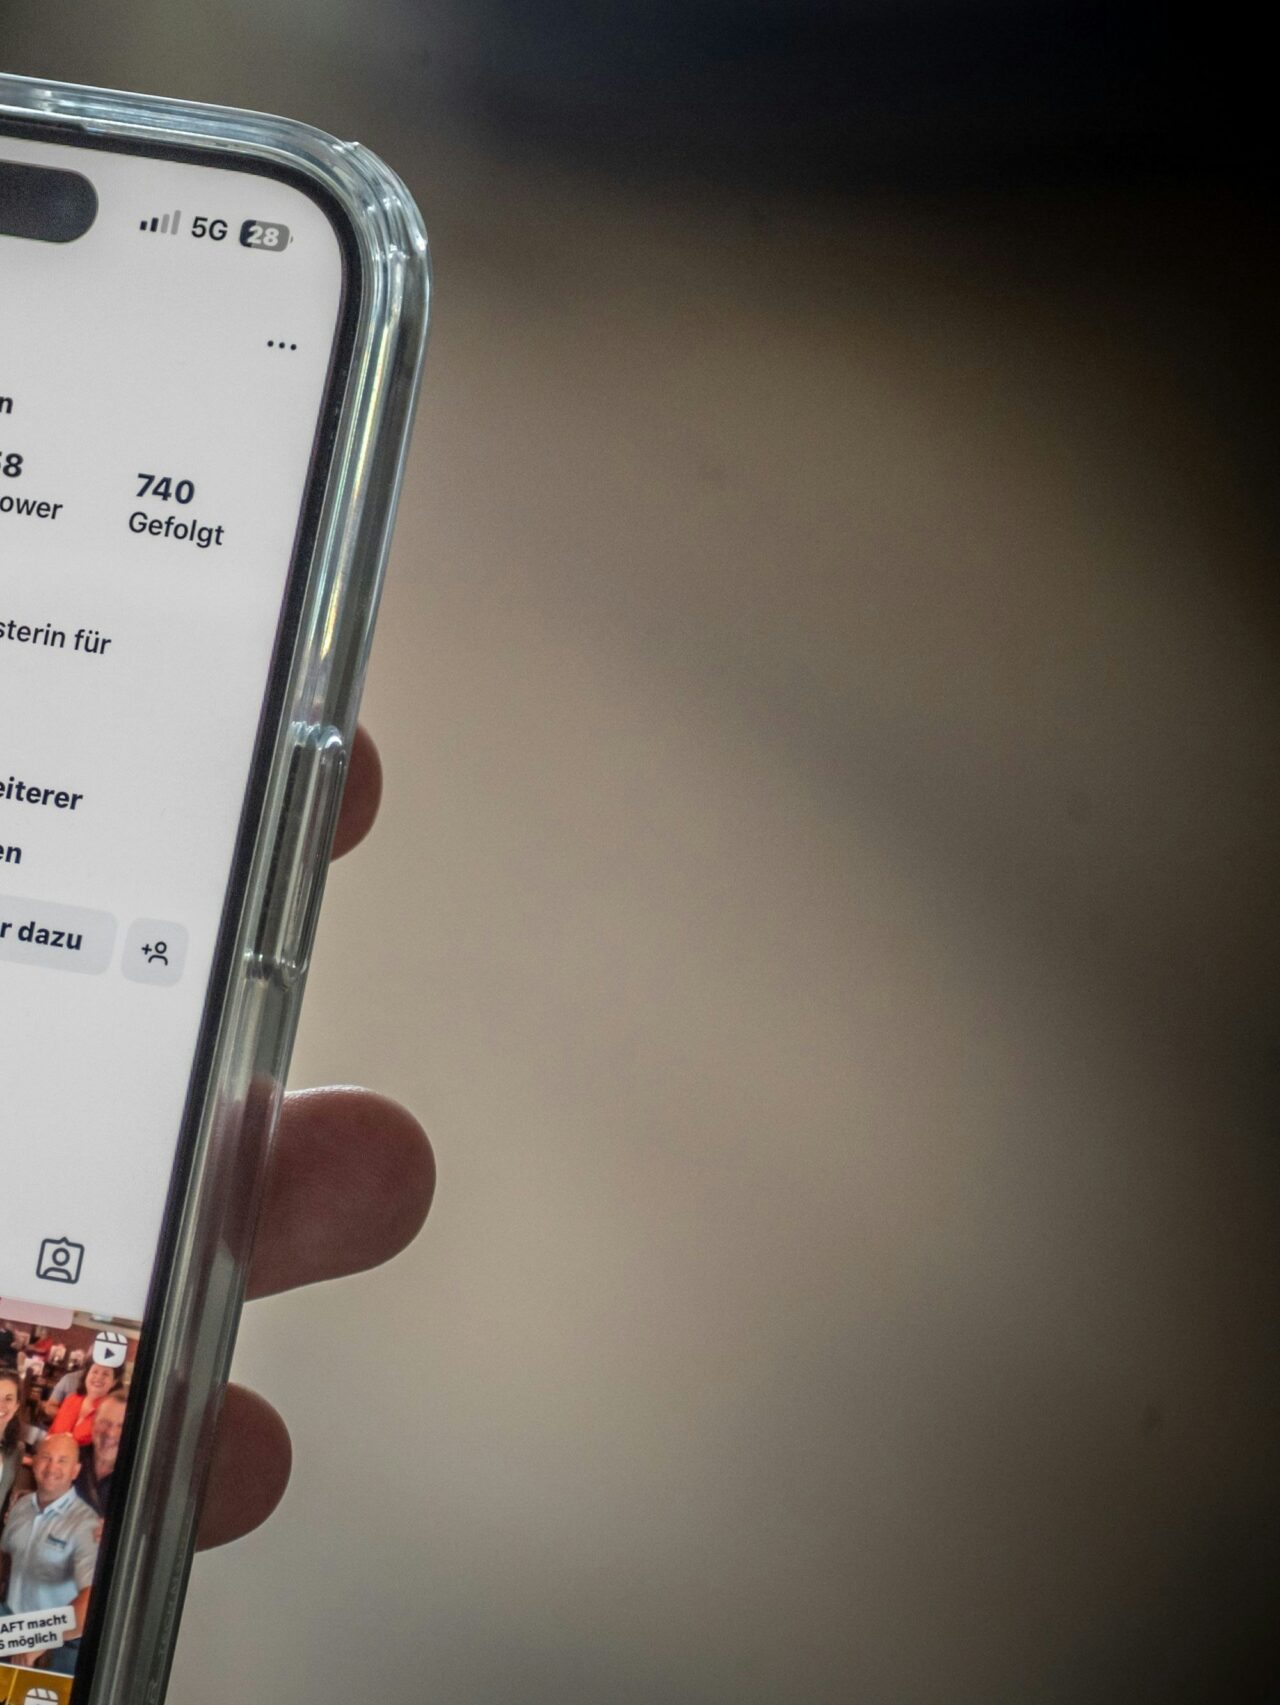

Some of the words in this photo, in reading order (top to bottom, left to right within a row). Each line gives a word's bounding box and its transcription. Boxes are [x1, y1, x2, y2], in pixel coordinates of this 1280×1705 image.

[191, 216, 228, 241] 5G
[247, 224, 279, 248] 28
[136, 473, 195, 504] 740
[129, 511, 224, 548] Gefolgt
[74, 629, 112, 654] für
[18, 921, 82, 950] dazu
[27, 1614, 68, 1630] macht
[8, 1631, 58, 1648] möglich
